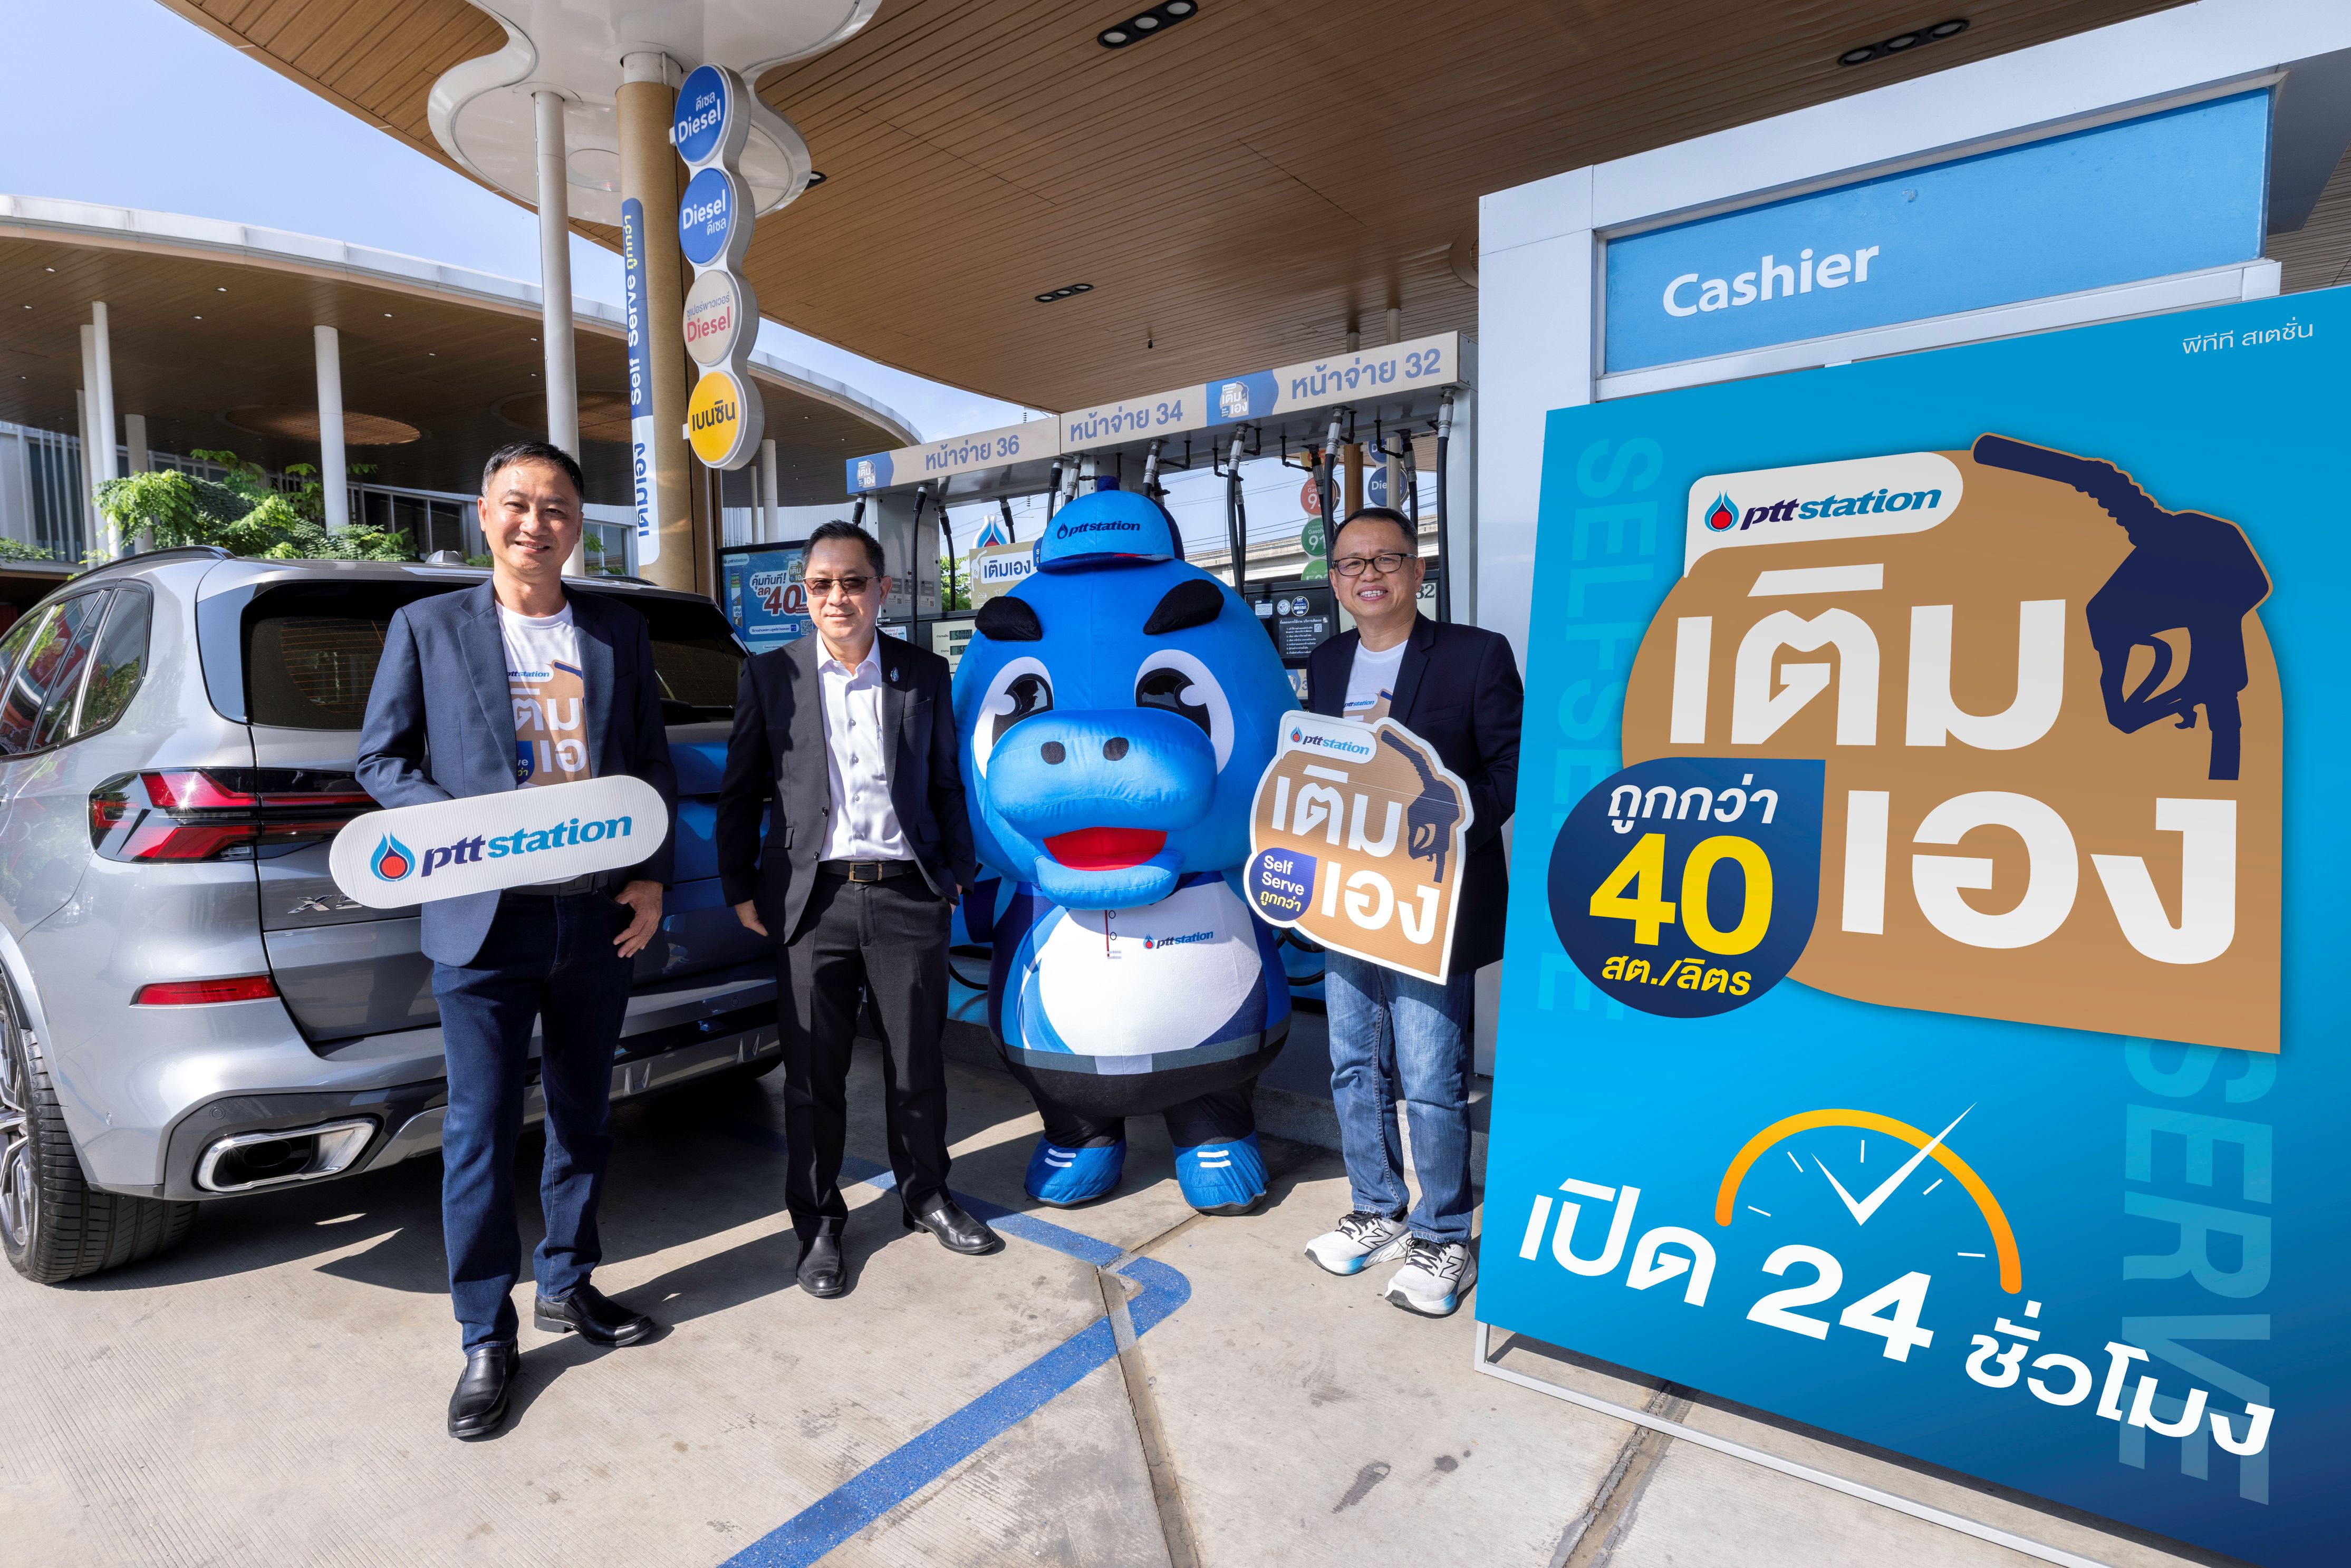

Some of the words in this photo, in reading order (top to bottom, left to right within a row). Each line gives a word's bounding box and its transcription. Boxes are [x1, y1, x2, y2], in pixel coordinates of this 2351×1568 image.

[678, 99, 721, 143] Diesel
[696, 91, 716, 112] ดีเซล
[682, 189, 726, 229] Diesel
[707, 217, 726, 236] ดีเซล
[623, 215, 638, 270] ถูกกว่า
[1662, 244, 1880, 317] Cashier
[627, 274, 639, 347] Serve
[687, 291, 730, 321] ซูเปอร์พาวเวอร์
[687, 306, 731, 343] Diesel
[2182, 330, 2234, 354] พีทีที
[2242, 316, 2313, 346] สเตชั่น
[629, 358, 642, 405] Self
[1292, 356, 1396, 400] หน้าจ่าย
[1405, 348, 1441, 379] 32
[692, 399, 736, 431] เบนซิน
[1222, 390, 1241, 404] เติม
[1231, 401, 1248, 414] เอง
[1070, 406, 1150, 442] หน้าจ่าย
[1156, 400, 1183, 425] 34
[925, 439, 991, 471] หน้าจ่าย
[996, 435, 1020, 458] 36
[634, 442, 650, 537] เตมเอง
[1308, 534, 1326, 551] 91
[1564, 435, 1664, 671] SELF
[751, 573, 786, 590] คุ้มทันที!
[984, 559, 1031, 578] เติมเอง
[764, 585, 802, 615] 40
[1670, 563, 2066, 750] เติม
[510, 688, 581, 731] ติม
[539, 739, 587, 772] เอ
[1271, 764, 1403, 857] เติม
[1607, 773, 1778, 834] ถูกกว่า
[1261, 872, 1305, 896] Serve
[1264, 855, 1293, 876] Self
[1842, 789, 2238, 965] เอง
[1260, 891, 1302, 912] ถูกกว่า
[1321, 860, 1441, 945] เอง
[1589, 833, 1773, 955] 40
[1601, 955, 1752, 996] สต./ลิตร
[1518, 1177, 1717, 1308] เปิด
[1746, 1243, 1934, 1363] 24
[1964, 1300, 2276, 1456] ชั่วโมง
